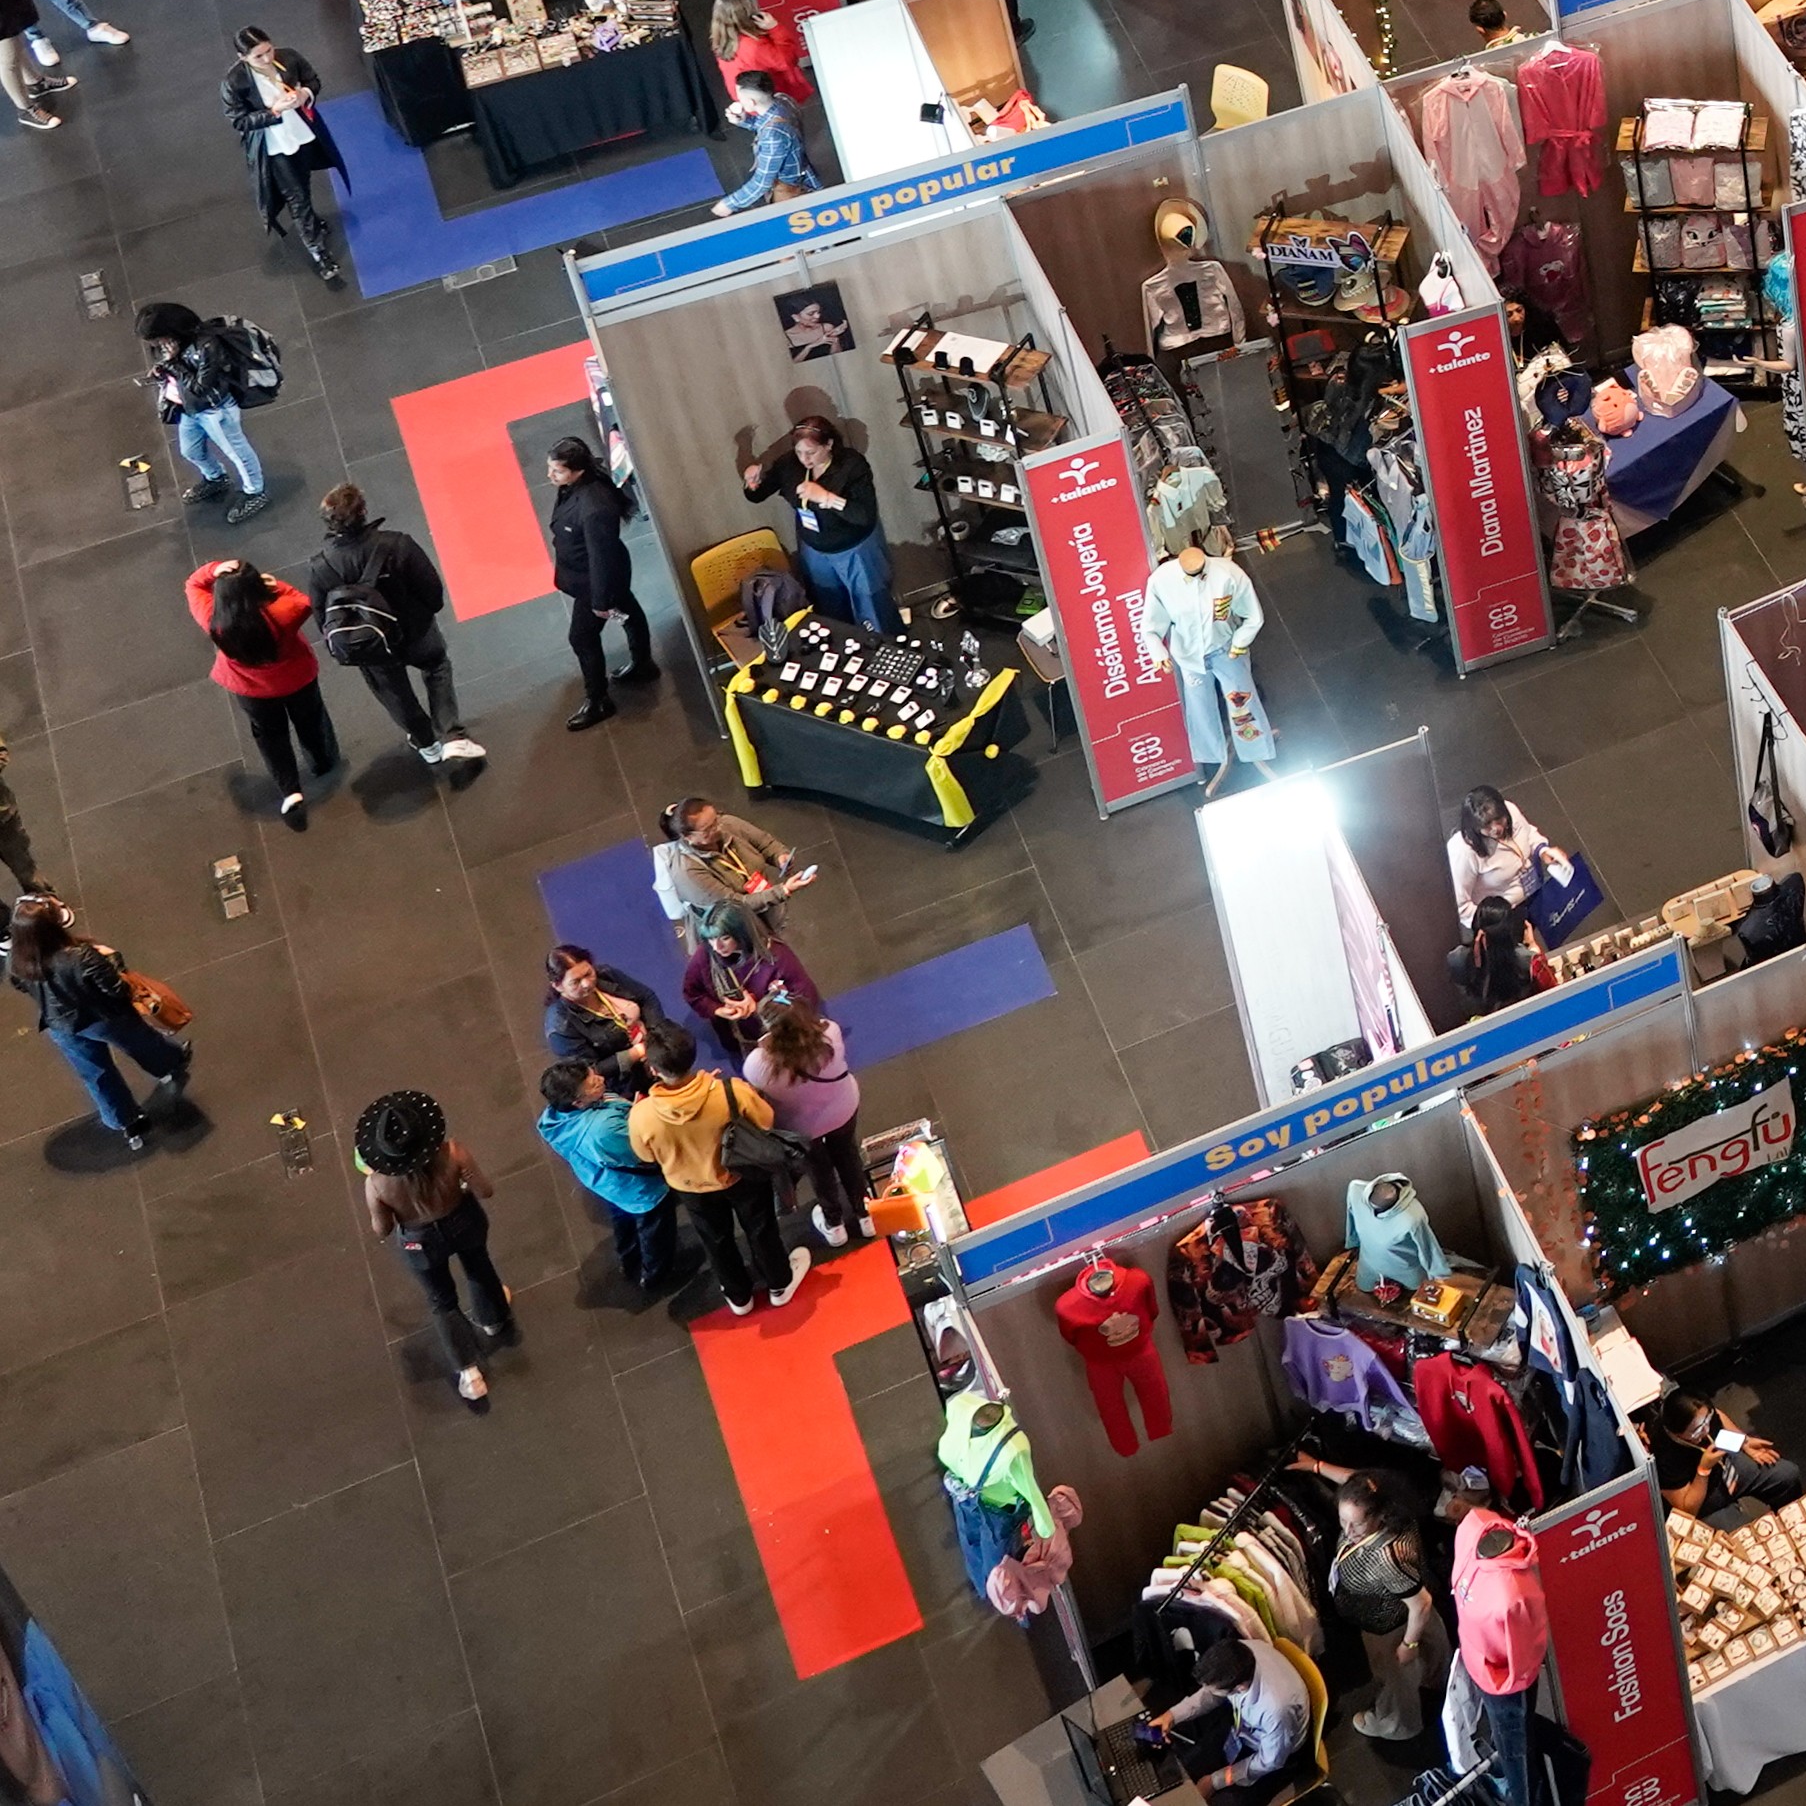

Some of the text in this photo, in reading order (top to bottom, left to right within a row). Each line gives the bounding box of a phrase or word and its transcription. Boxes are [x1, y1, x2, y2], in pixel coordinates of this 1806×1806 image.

[789, 154, 1016, 234] Soy popular
[1267, 244, 1334, 264] DIANAM
[1481, 501, 1503, 557] Diana
[1068, 522, 1130, 699] Diséñame Joyería
[1205, 1042, 1477, 1173] Soy popular
[1599, 1588, 1642, 1724] Fashion Soes
